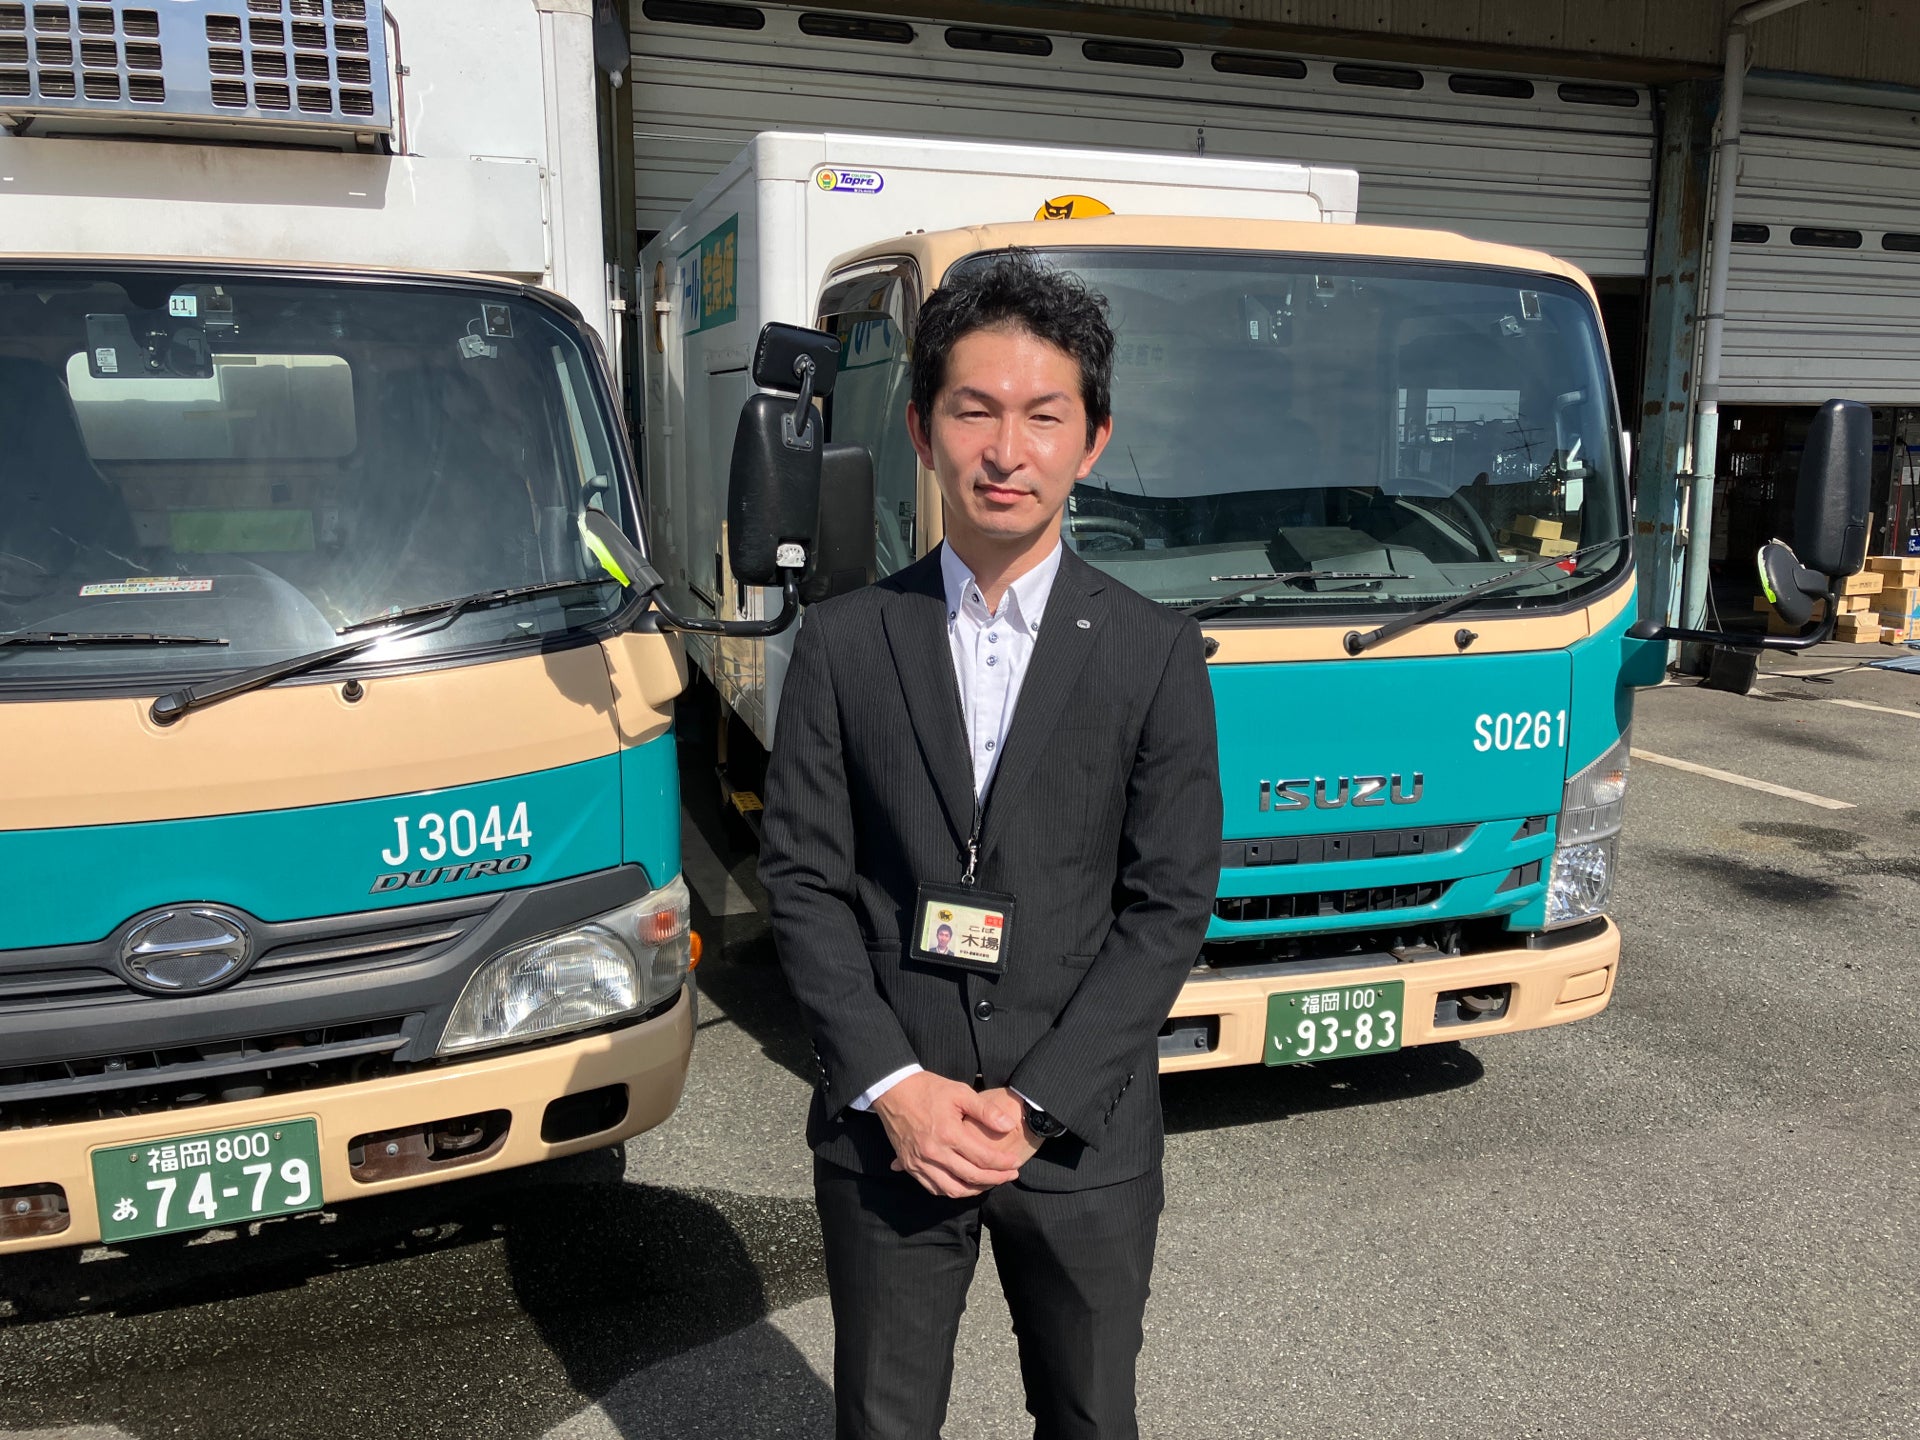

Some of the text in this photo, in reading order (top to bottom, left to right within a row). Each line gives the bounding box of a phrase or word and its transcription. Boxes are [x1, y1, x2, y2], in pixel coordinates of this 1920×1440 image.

[840, 173, 875, 186] Topre
[171, 298, 188, 311] 11
[1473, 709, 1567, 753] S0261
[1258, 771, 1425, 813] ISUZU
[381, 801, 533, 866] J3044
[368, 853, 533, 895] DUTRO
[961, 934, 999, 950] 木場
[1296, 1009, 1397, 1057] 93-83
[112, 1157, 312, 1229] あ 74-79
